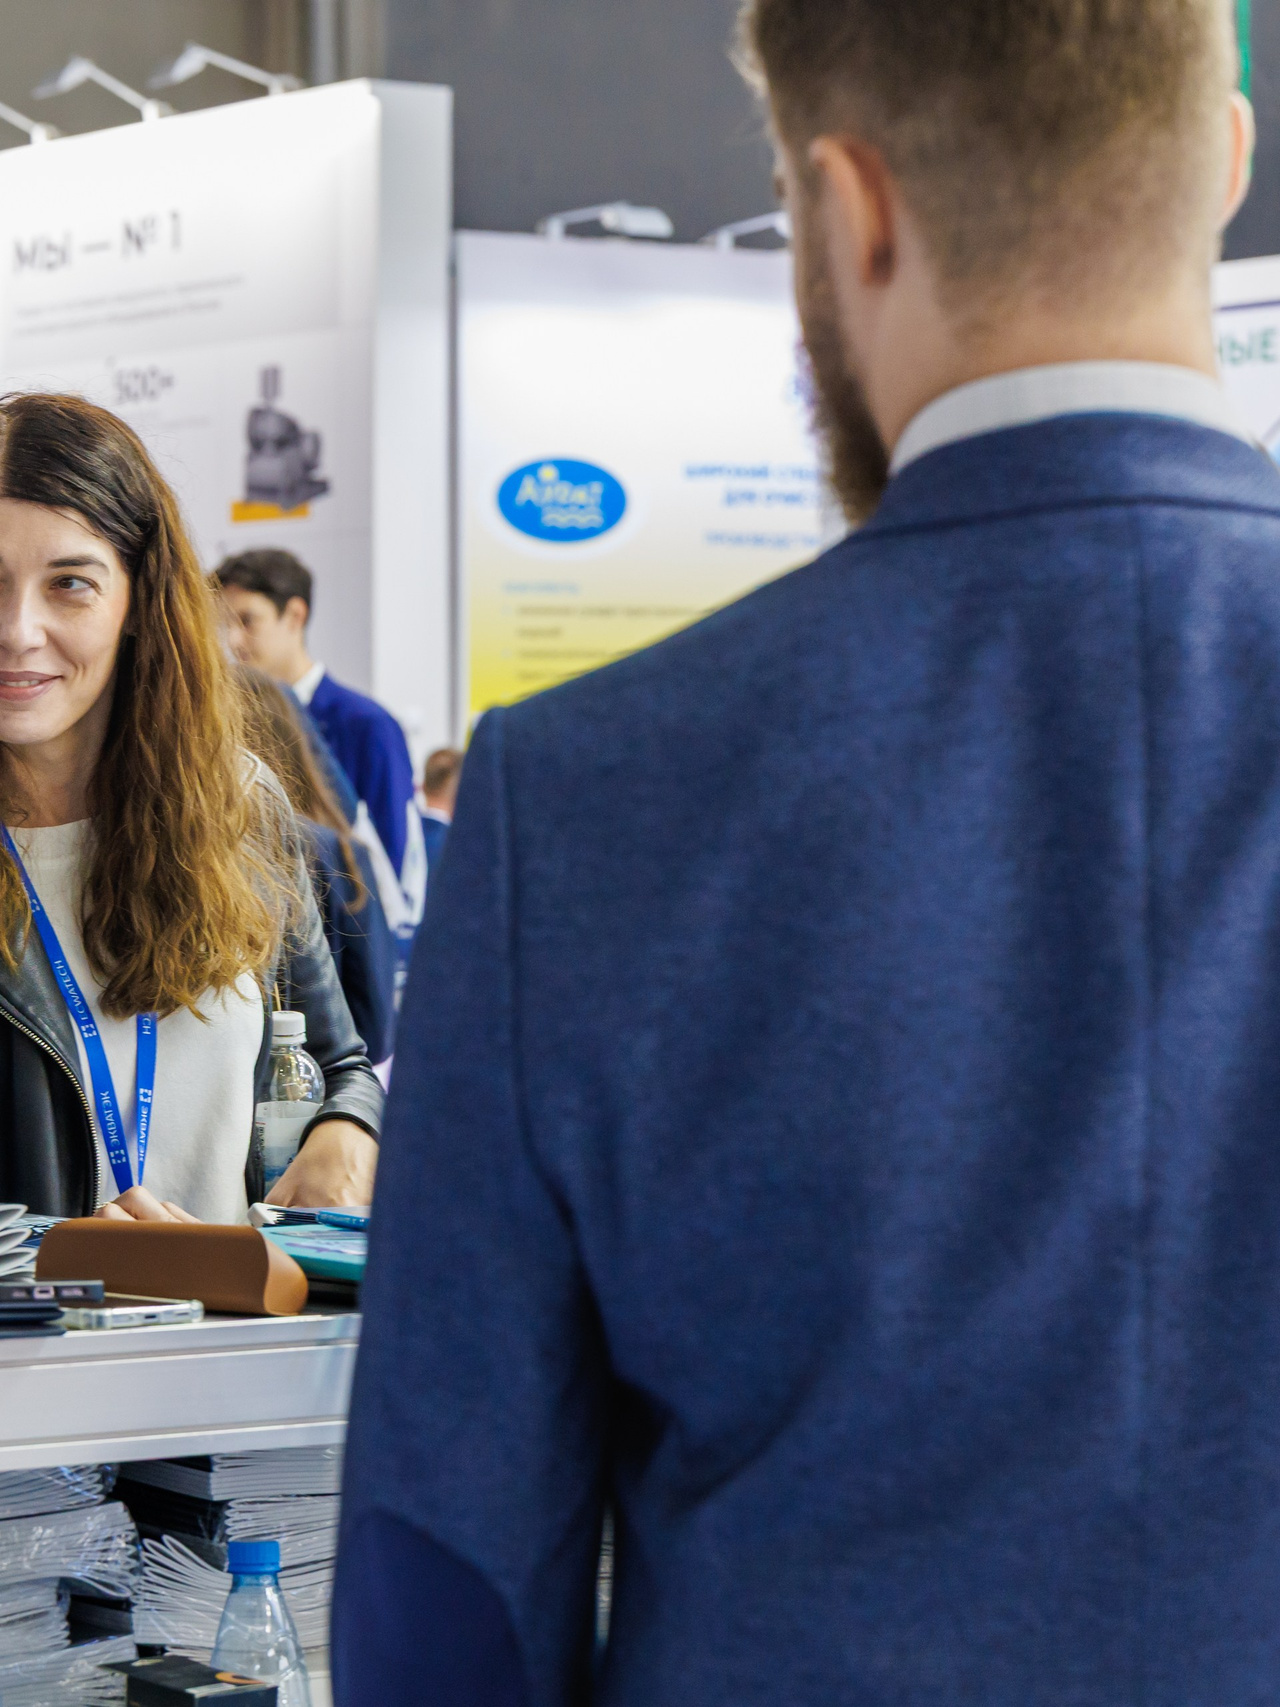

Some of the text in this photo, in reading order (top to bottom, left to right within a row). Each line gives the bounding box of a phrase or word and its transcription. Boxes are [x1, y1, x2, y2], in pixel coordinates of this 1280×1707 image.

[12, 233, 72, 273] МЫ
[53, 960, 89, 1021] ECWATECH
[100, 1090, 121, 1147] ЭКВАТЭК
